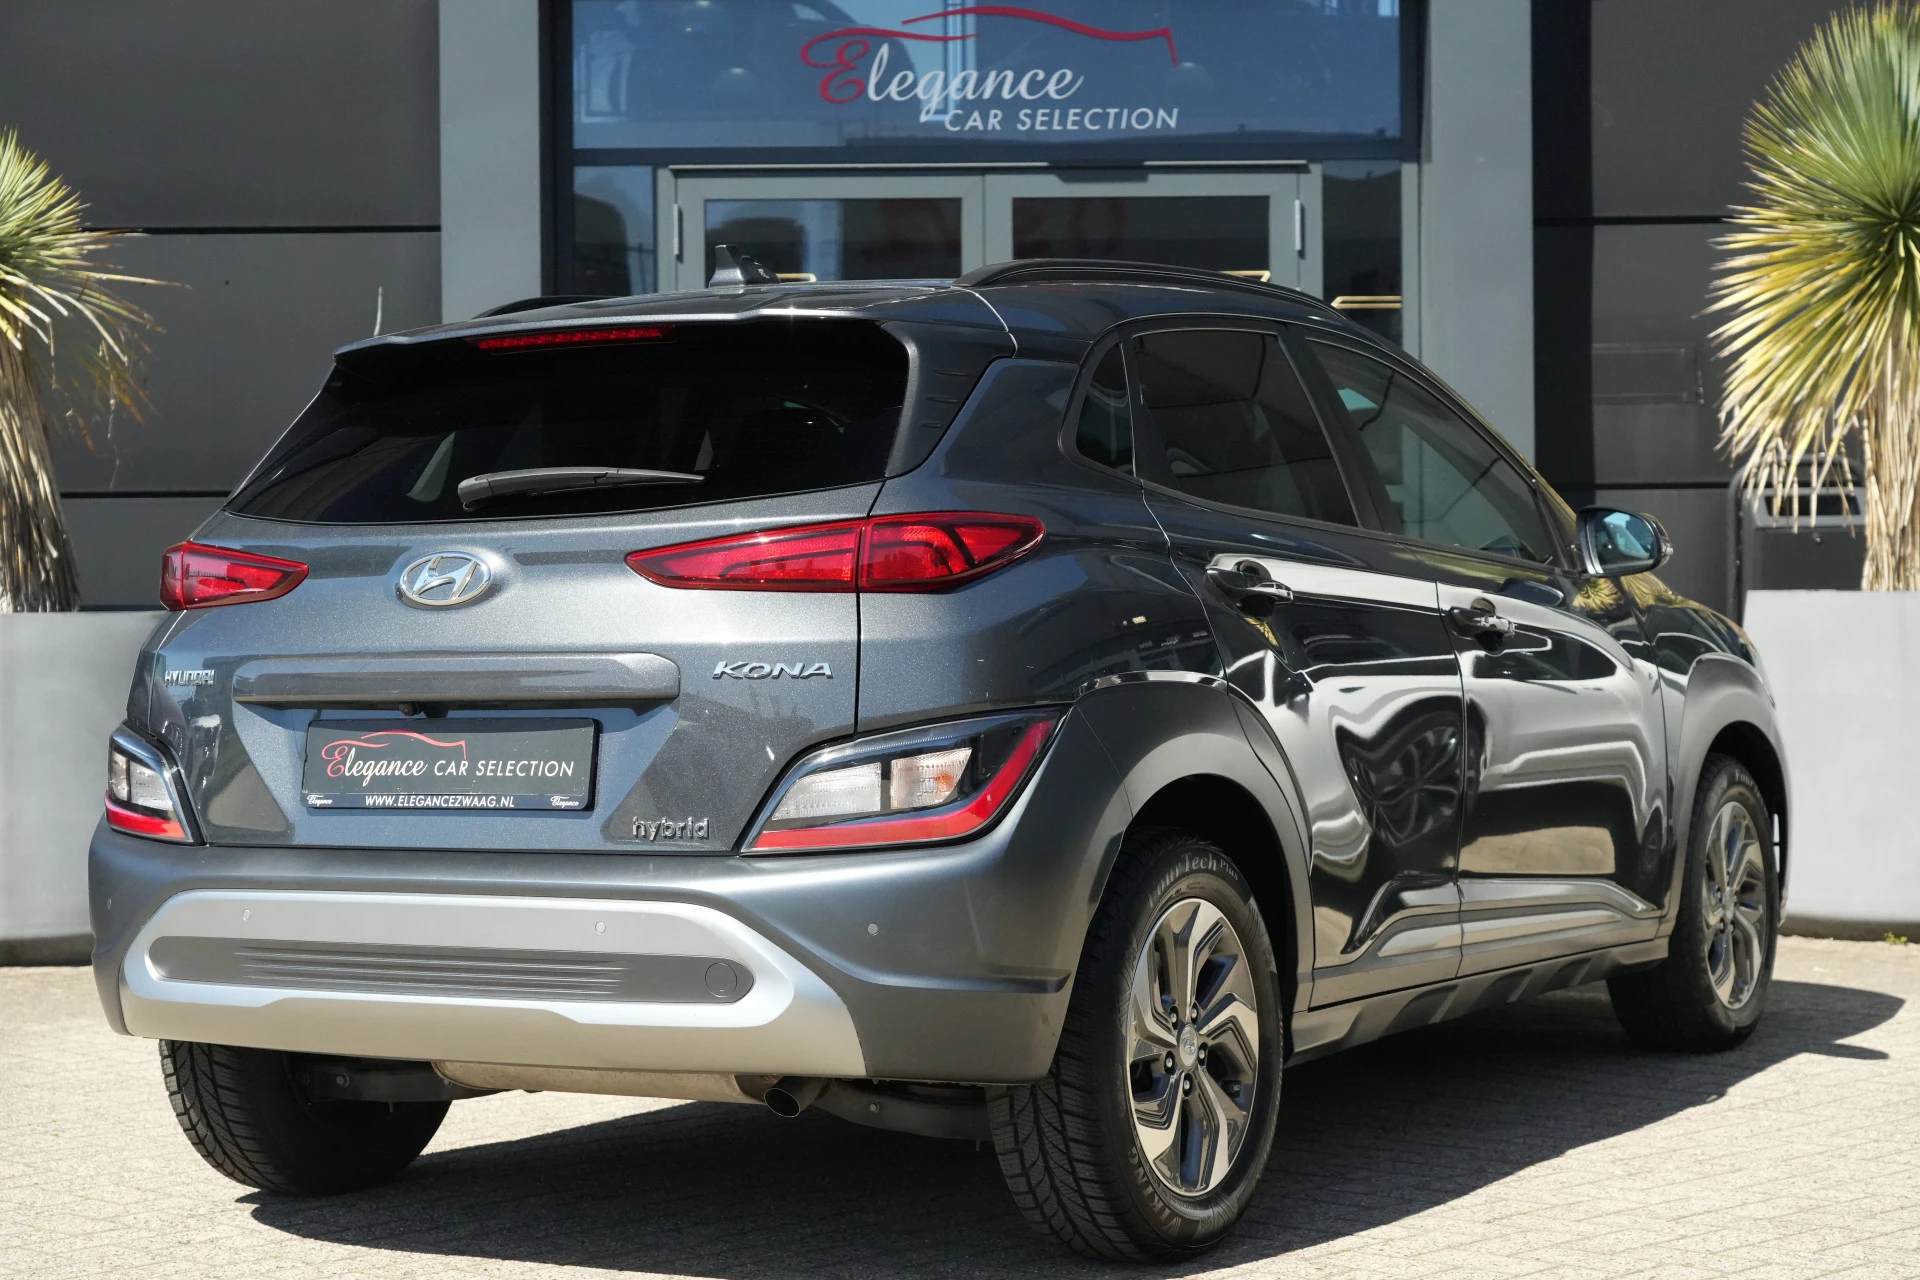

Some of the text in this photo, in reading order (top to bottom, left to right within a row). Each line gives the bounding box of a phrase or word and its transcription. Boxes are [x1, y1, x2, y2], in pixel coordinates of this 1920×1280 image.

[800, 28, 1084, 123] Elegance
[944, 107, 1178, 131] CAR SELECTION
[164, 669, 215, 687] HYUNDAI
[712, 661, 833, 679] KONA
[322, 739, 575, 787] Elegance CAR SELECTION
[365, 795, 515, 808] WWW.ELEGANCEZWAAG.NL
[632, 816, 710, 841] hybrid
